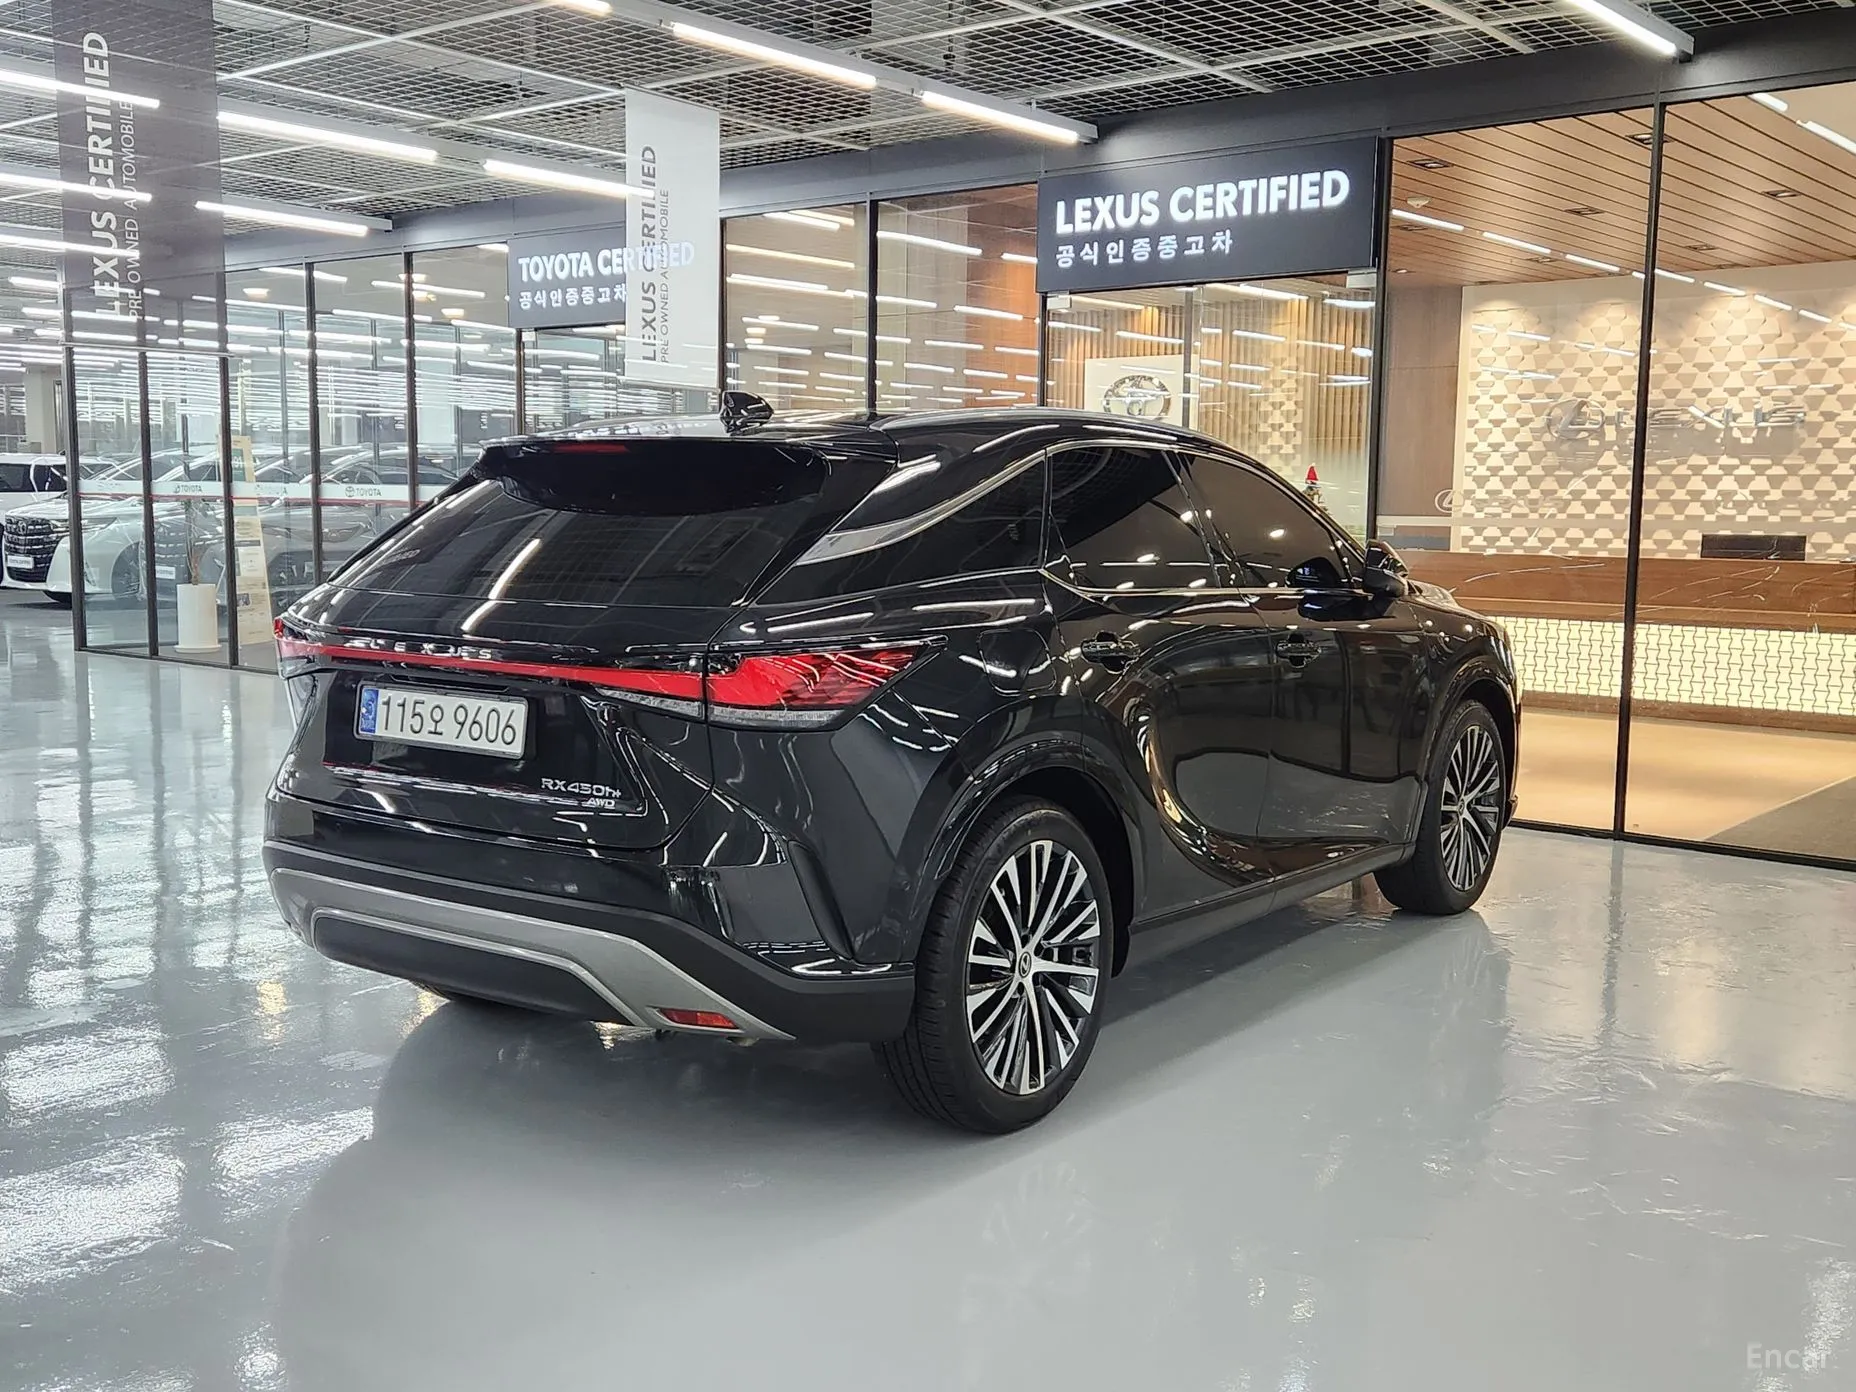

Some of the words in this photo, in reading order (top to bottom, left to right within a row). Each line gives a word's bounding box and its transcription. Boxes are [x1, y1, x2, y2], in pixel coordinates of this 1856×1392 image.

[119, 100, 138, 211] AUTOMOBILE
[641, 145, 656, 272] CERTIIED
[1055, 190, 1160, 235] LEXUS
[1169, 169, 1350, 223] CERTIFIED
[91, 210, 120, 317] LEXUS
[518, 252, 595, 282] TOYOTA
[641, 280, 656, 361] LEXUS
[180, 485, 203, 493] TOYOTA
[356, 488, 382, 497] TOYOTA
[381, 694, 445, 736] 115오
[453, 703, 517, 746] 9606
[587, 797, 616, 809] AWD
